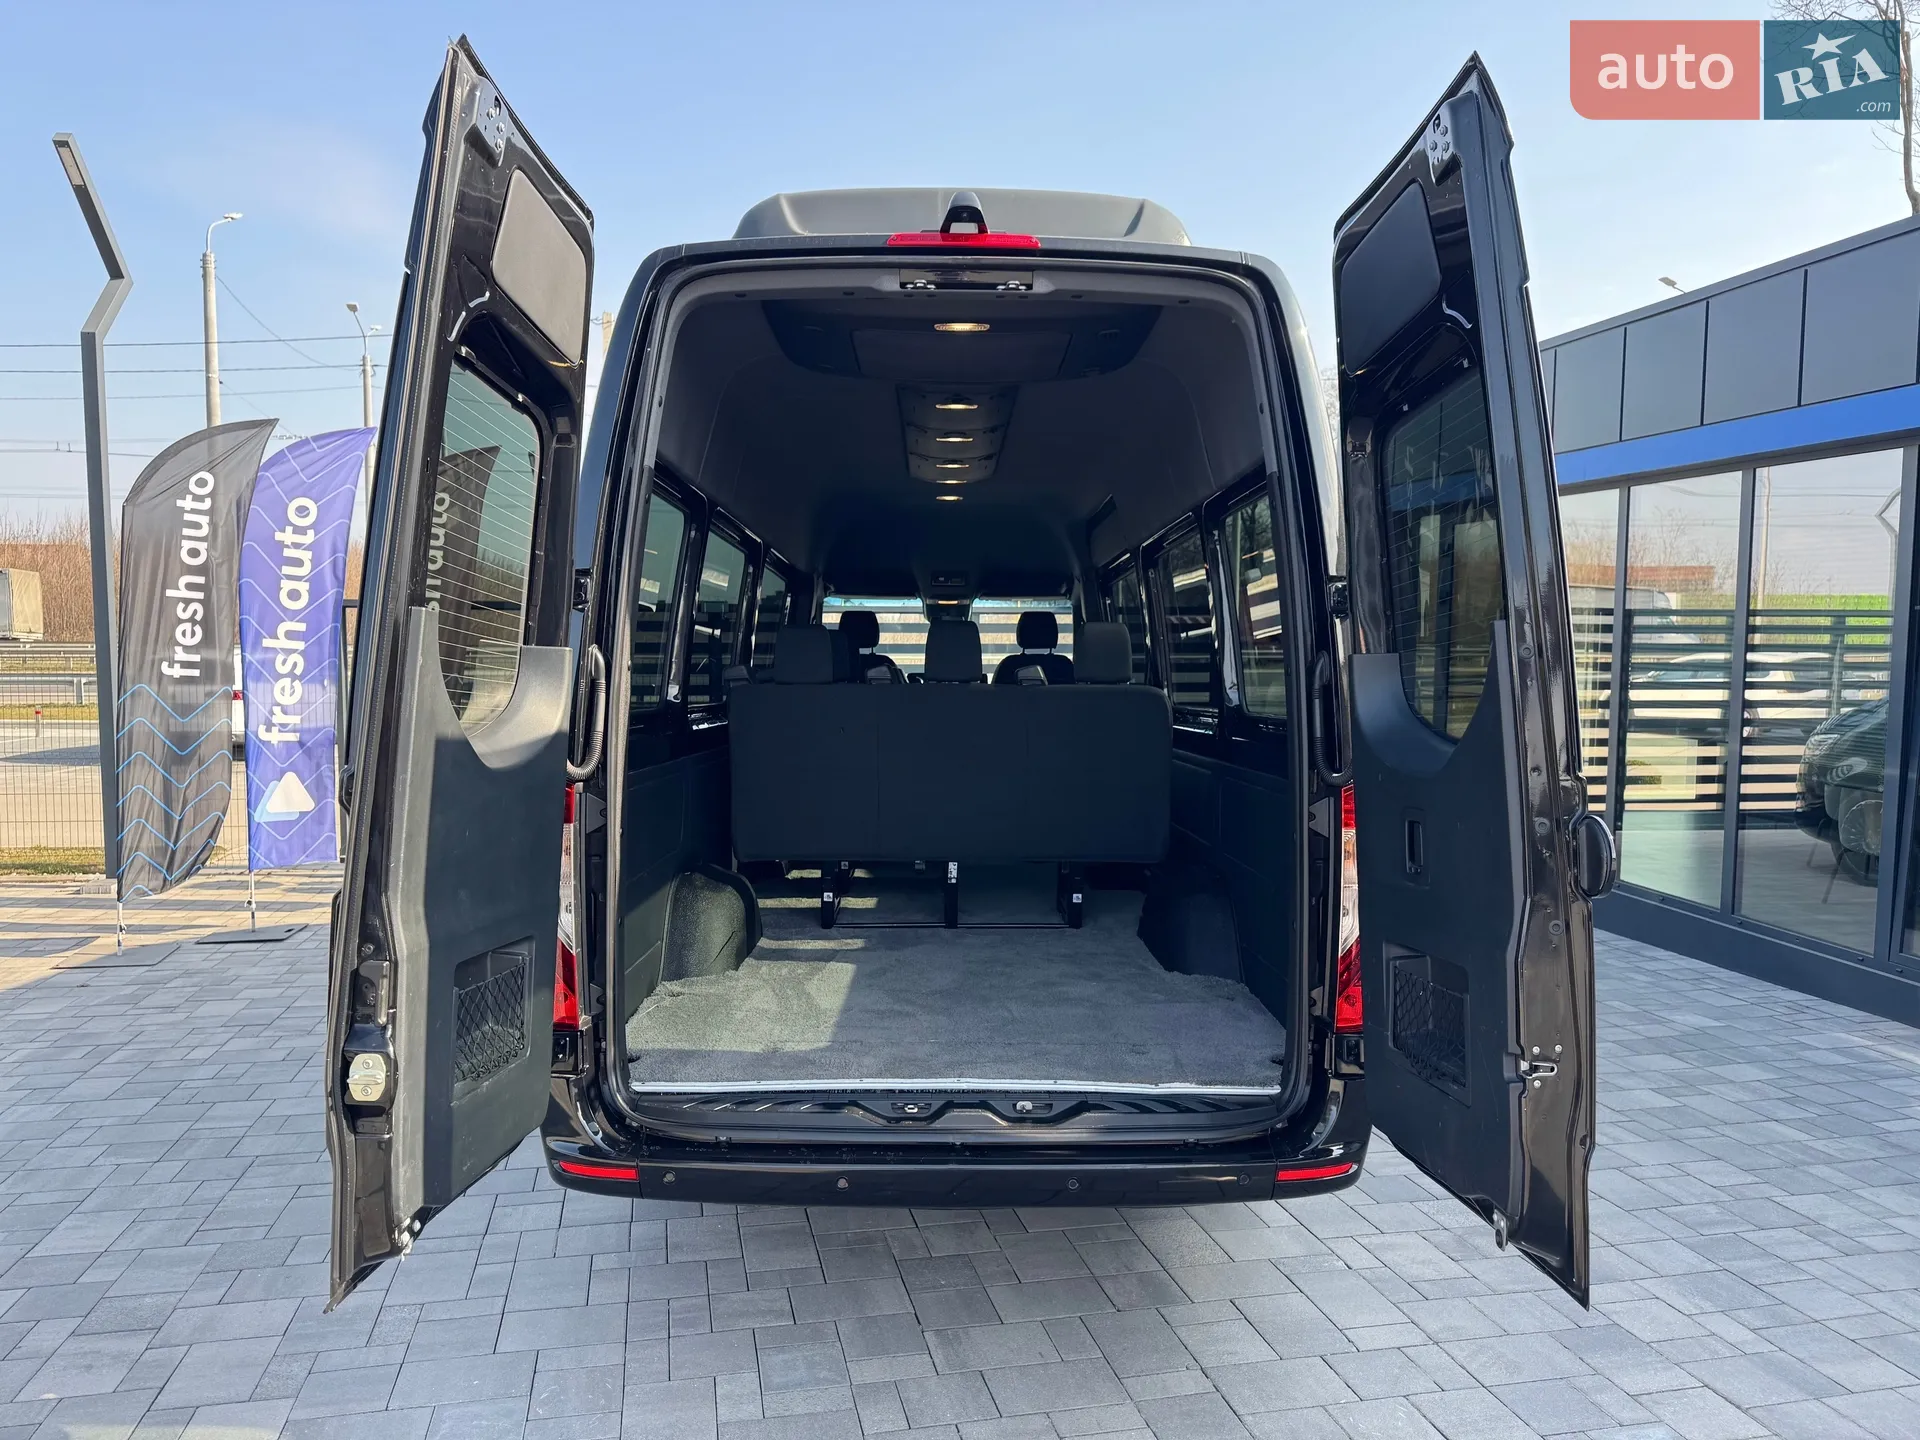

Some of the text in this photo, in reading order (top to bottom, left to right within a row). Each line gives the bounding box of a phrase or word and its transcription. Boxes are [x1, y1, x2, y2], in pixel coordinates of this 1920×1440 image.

[161, 470, 215, 679] fresh auto
[258, 496, 318, 746] fresh auto
